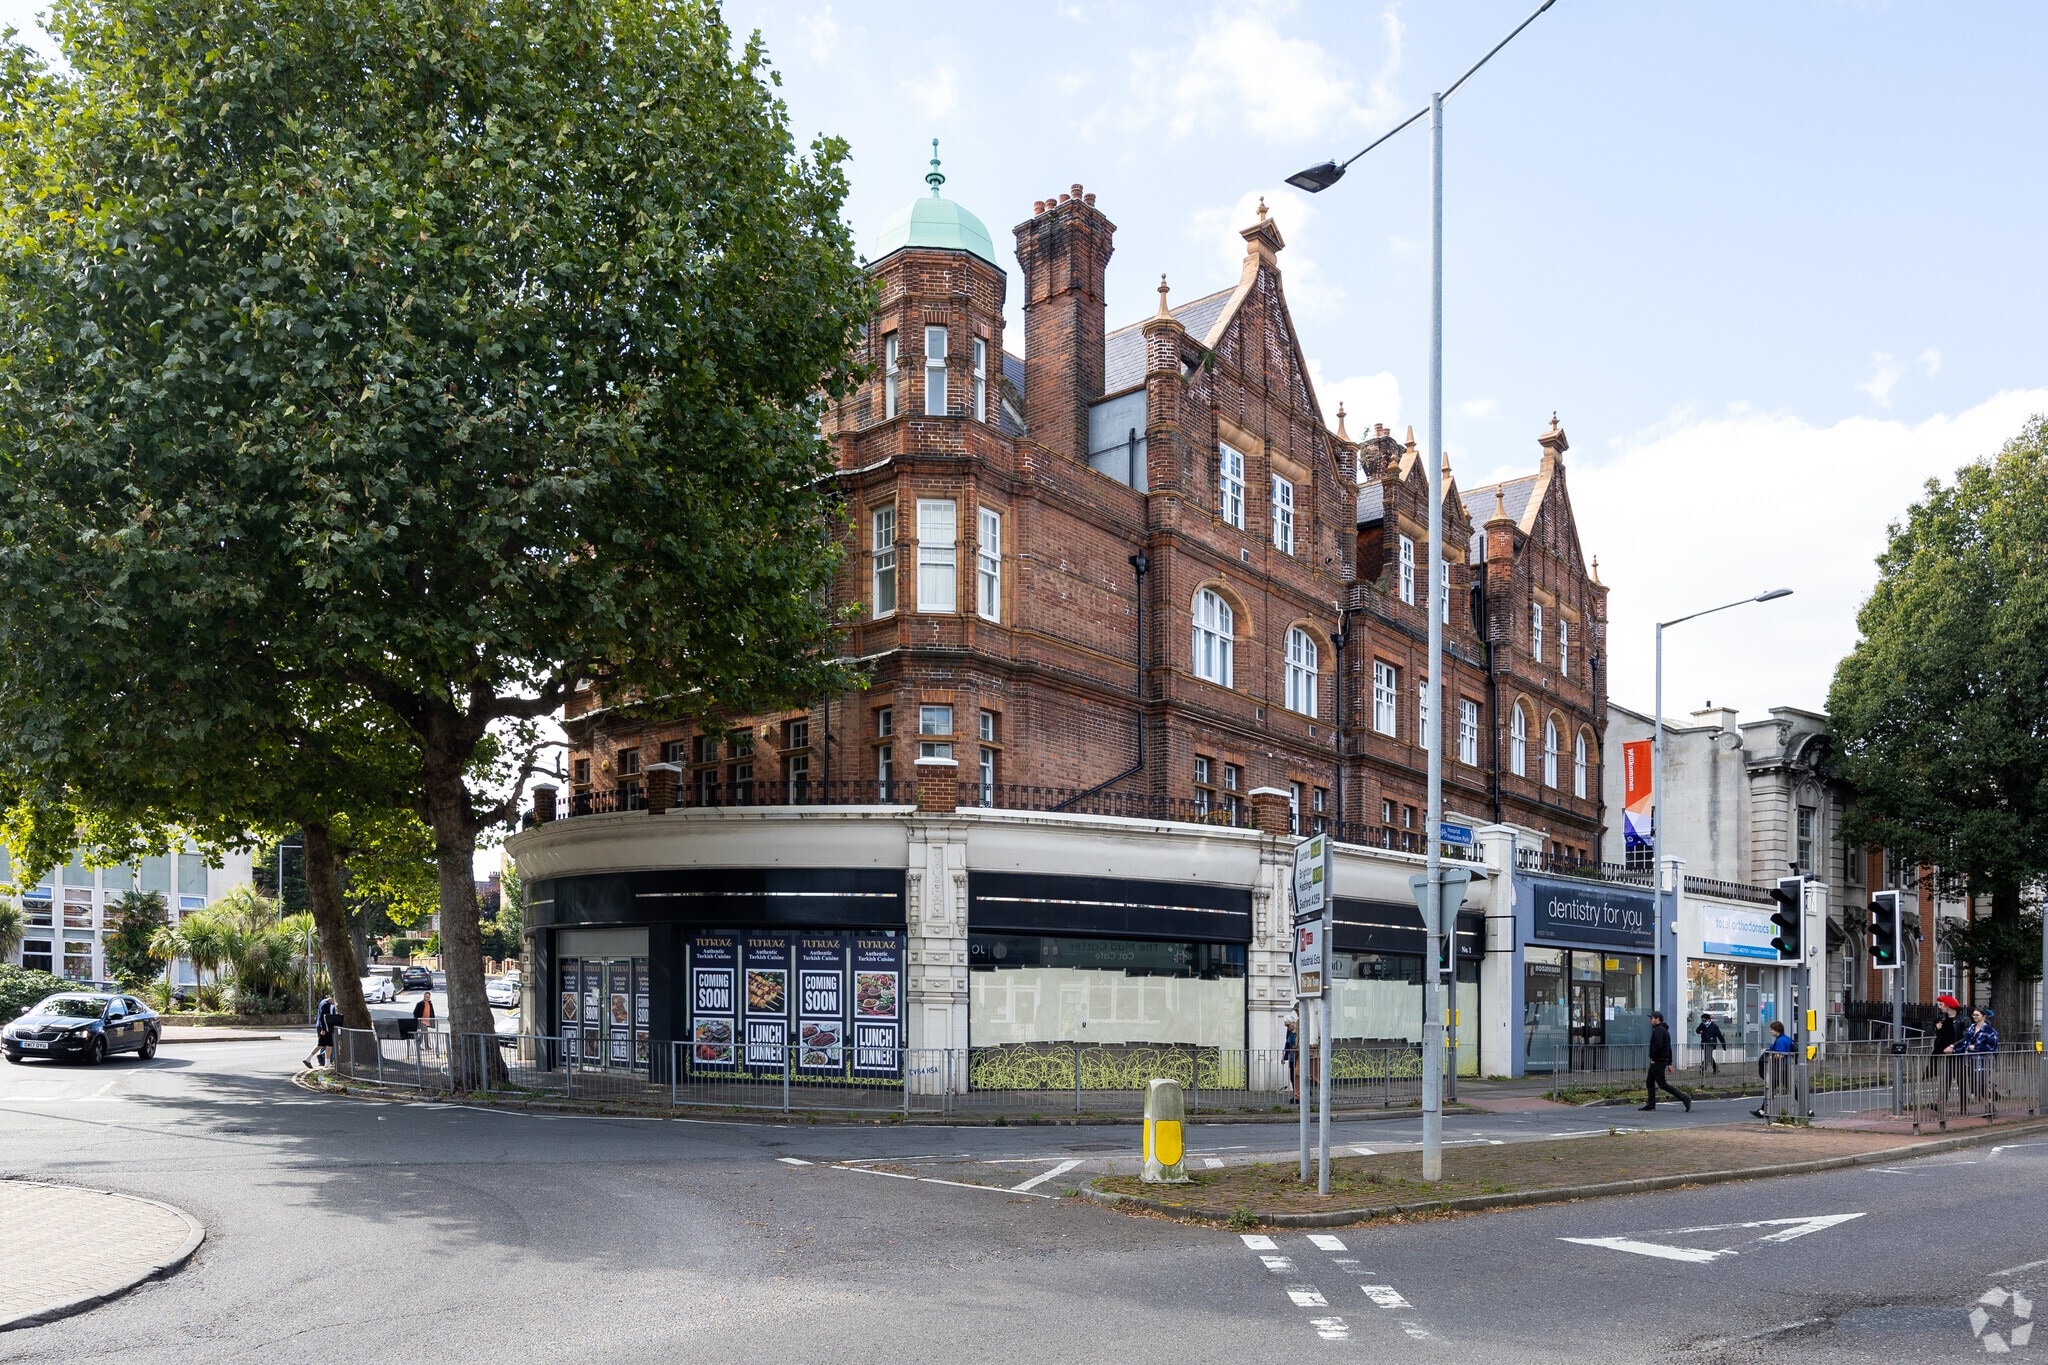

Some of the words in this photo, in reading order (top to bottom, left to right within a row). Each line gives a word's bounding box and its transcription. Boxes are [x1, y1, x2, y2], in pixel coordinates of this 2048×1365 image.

[1549, 896, 1600, 926] dentistry
[1603, 902, 1619, 924] for
[1622, 910, 1642, 929] you
[1716, 918, 1730, 929] total
[1731, 920, 1769, 934] orthodontics
[696, 938, 732, 947] TURKUAZ
[748, 939, 785, 948] TURKUAZ
[802, 940, 840, 948] TURKUAZ
[857, 941, 896, 949] TURKUAZ
[699, 974, 729, 987] COMING
[806, 976, 836, 990] COMING
[699, 989, 729, 1008] SOON
[805, 991, 836, 1011] SOON
[638, 1008, 649, 1022] SOO
[750, 1025, 782, 1043] LUNCH
[860, 1028, 892, 1047] LUNCH
[750, 1044, 782, 1060] DINNER
[860, 1047, 892, 1065] DINNER
